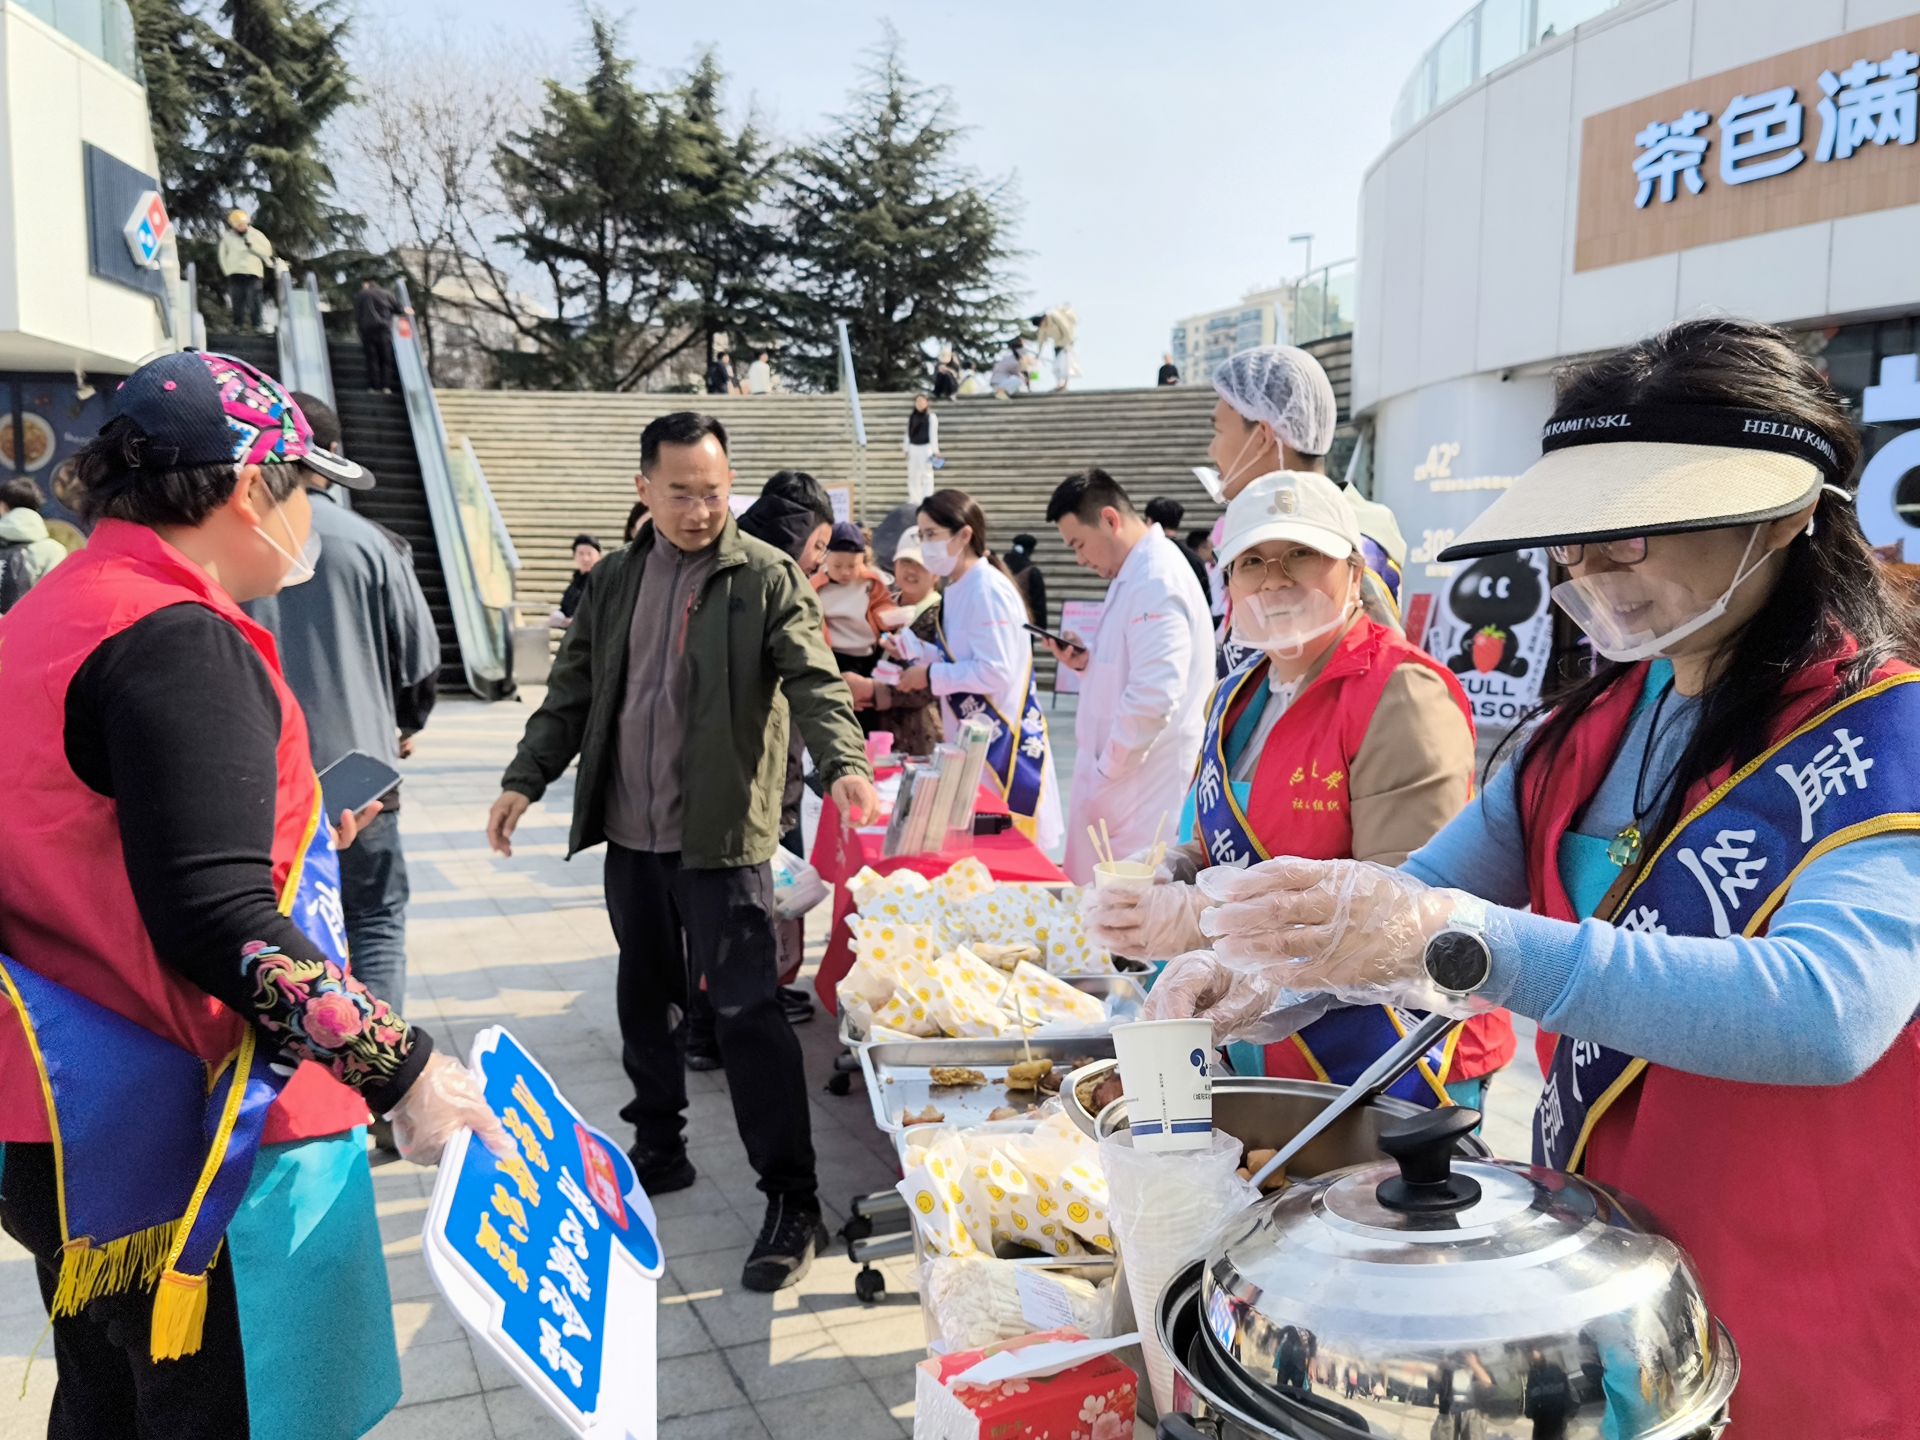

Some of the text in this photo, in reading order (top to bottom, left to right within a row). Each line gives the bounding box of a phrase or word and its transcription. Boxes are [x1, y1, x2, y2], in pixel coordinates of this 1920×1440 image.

[1632, 48, 1920, 209] 茶色满
[1459, 678, 1516, 697] ULL
[539, 1166, 600, 1388] 用心做食品
